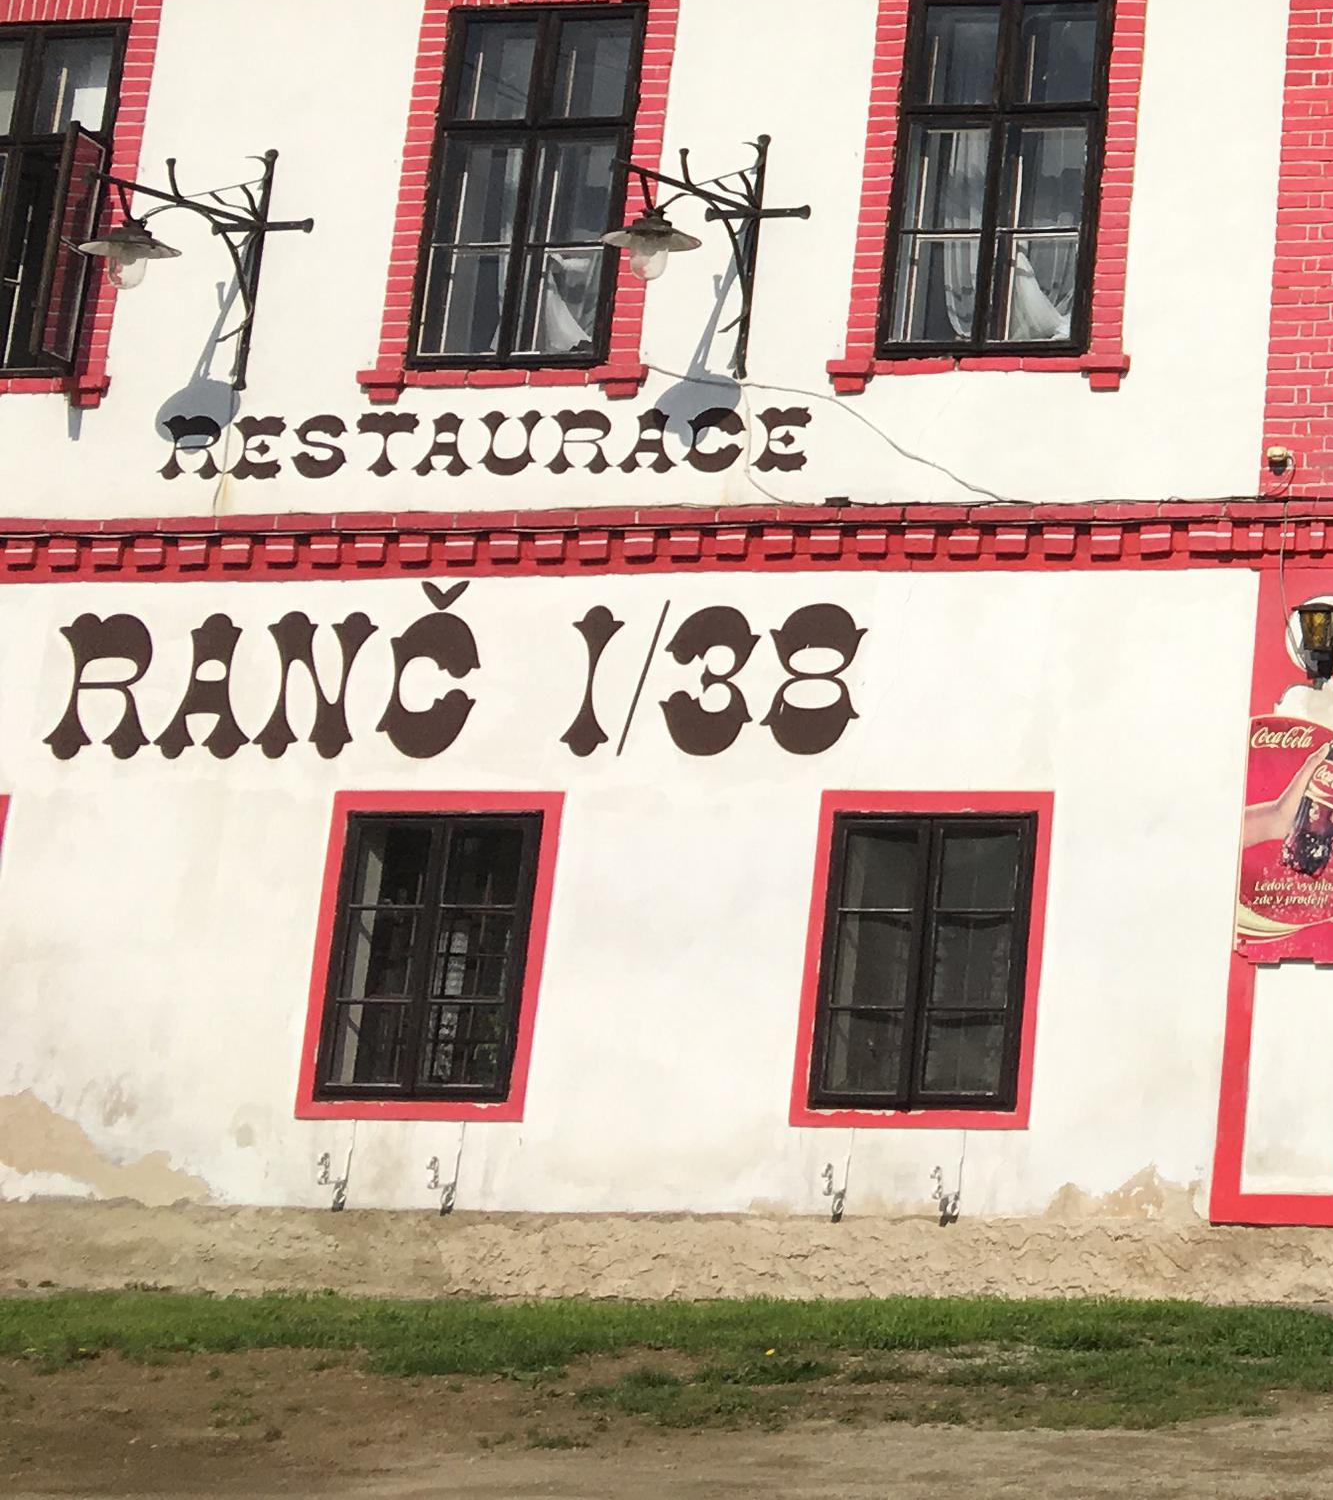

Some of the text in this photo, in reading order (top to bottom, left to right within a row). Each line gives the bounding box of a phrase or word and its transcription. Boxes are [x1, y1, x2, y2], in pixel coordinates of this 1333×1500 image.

[157, 406, 813, 480] RESTAURACE
[43, 581, 481, 761] RANČ
[1250, 725, 1315, 749] Coca-Cola
[1252, 894, 1274, 905] zde
